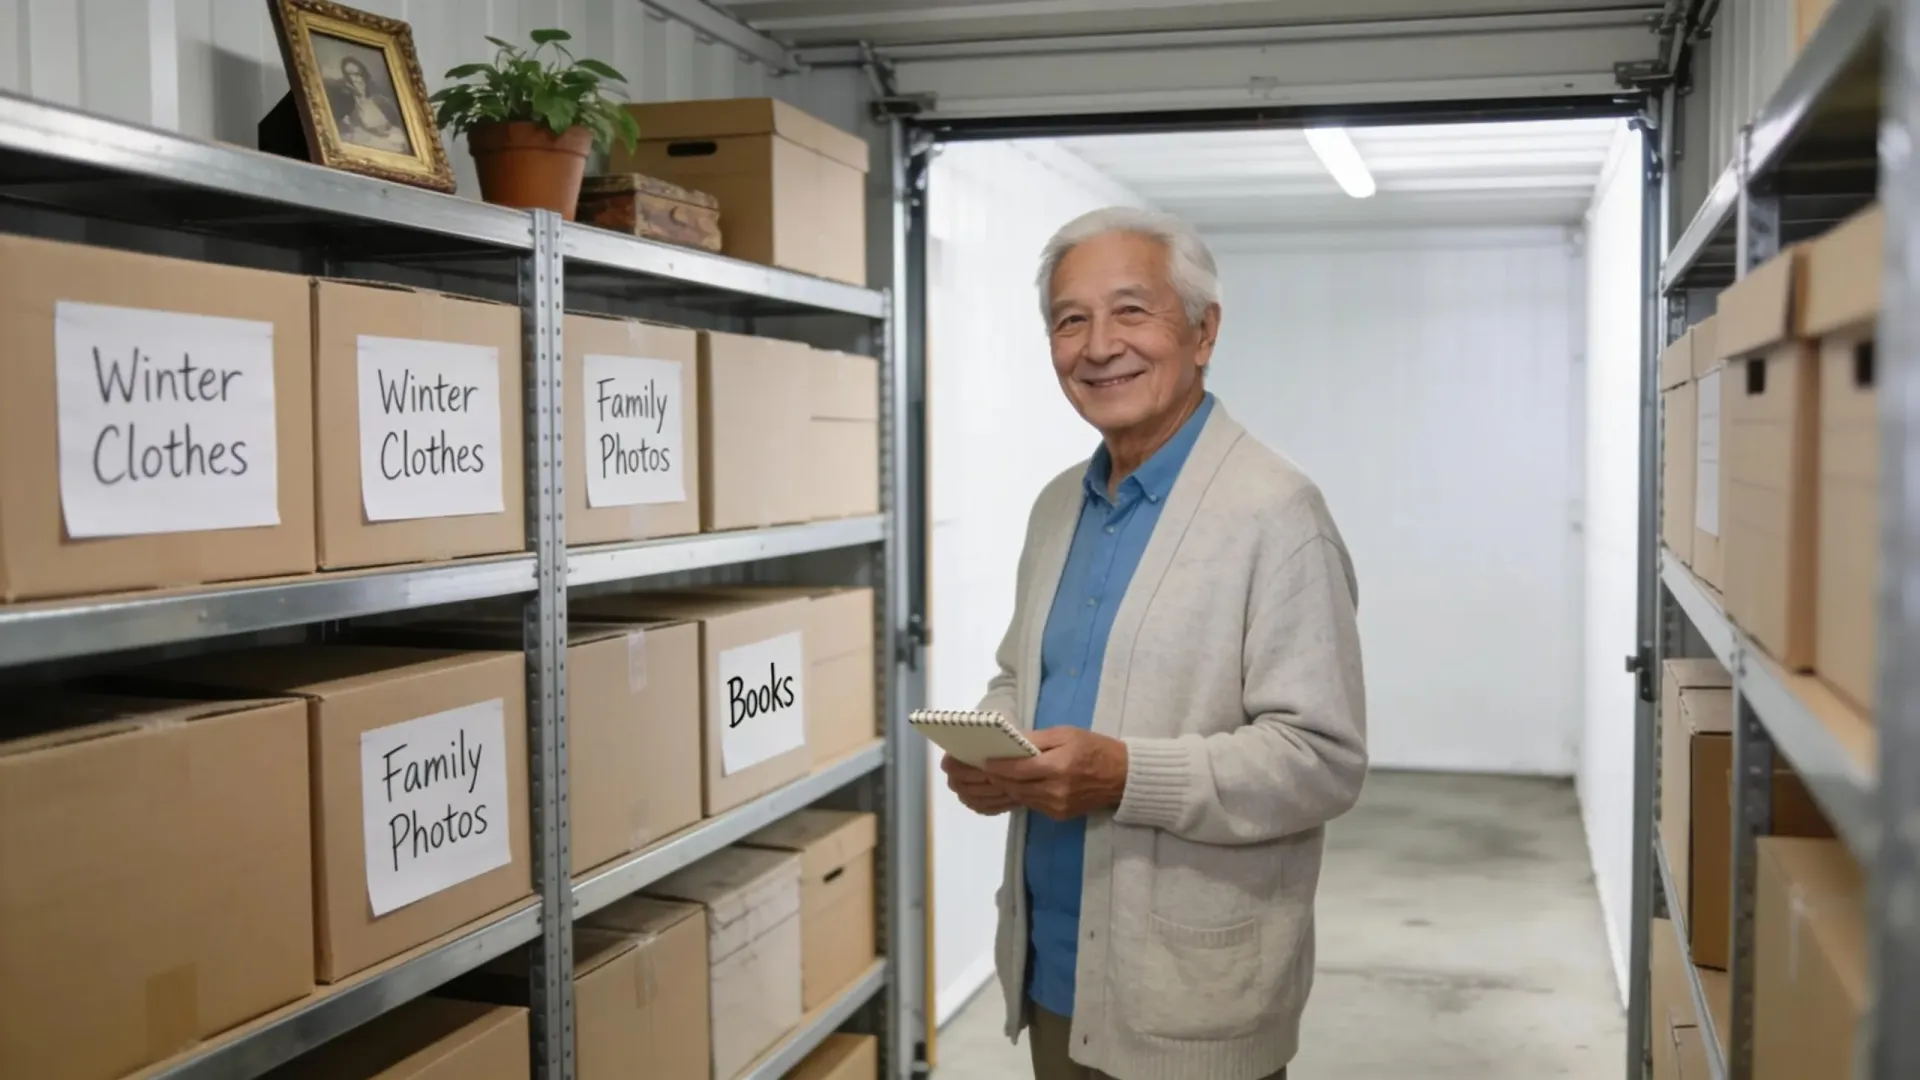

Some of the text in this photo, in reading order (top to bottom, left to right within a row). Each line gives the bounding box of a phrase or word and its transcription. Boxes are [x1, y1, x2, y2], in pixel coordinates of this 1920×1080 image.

[92, 346, 243, 404] Winter
[378, 368, 478, 414] Winter
[597, 378, 668, 433] Family
[92, 423, 249, 486] Clothes
[380, 430, 485, 481] Clothes
[600, 432, 670, 478] Photos
[727, 662, 794, 728] Books
[382, 729, 482, 803] Family
[389, 804, 488, 872] Photos
